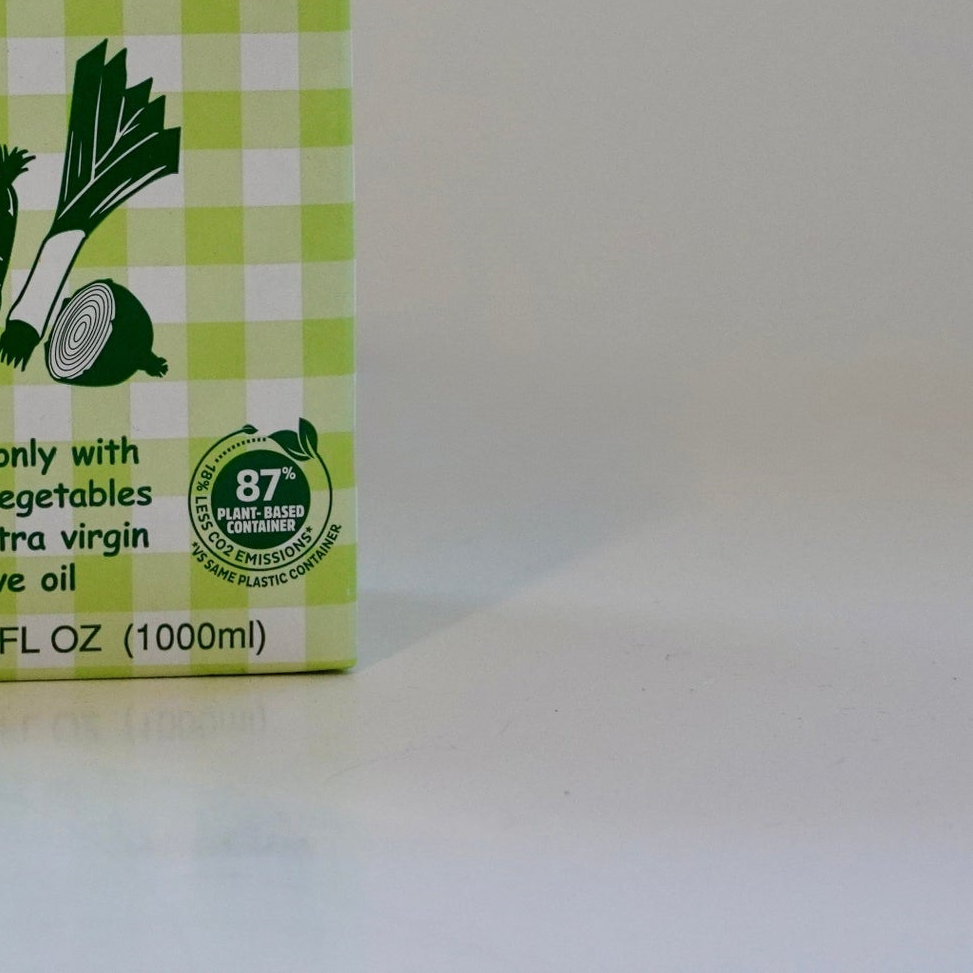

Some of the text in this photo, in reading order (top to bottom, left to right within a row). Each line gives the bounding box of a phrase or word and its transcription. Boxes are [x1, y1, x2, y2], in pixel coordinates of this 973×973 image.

[72, 435, 139, 466] with
[196, 464, 216, 492] 18%
[195, 495, 214, 531] LESS
[227, 519, 295, 534] CONTAINER
[61, 521, 149, 557] virgin
[208, 530, 235, 557] CO2
[204, 558, 237, 584] SAME
[237, 573, 288, 588] PLASTIC
[289, 523, 342, 580] CONTAINER
[41, 562, 76, 591] oil
[51, 624, 102, 653] OZ
[123, 619, 267, 658] (1000ml)
